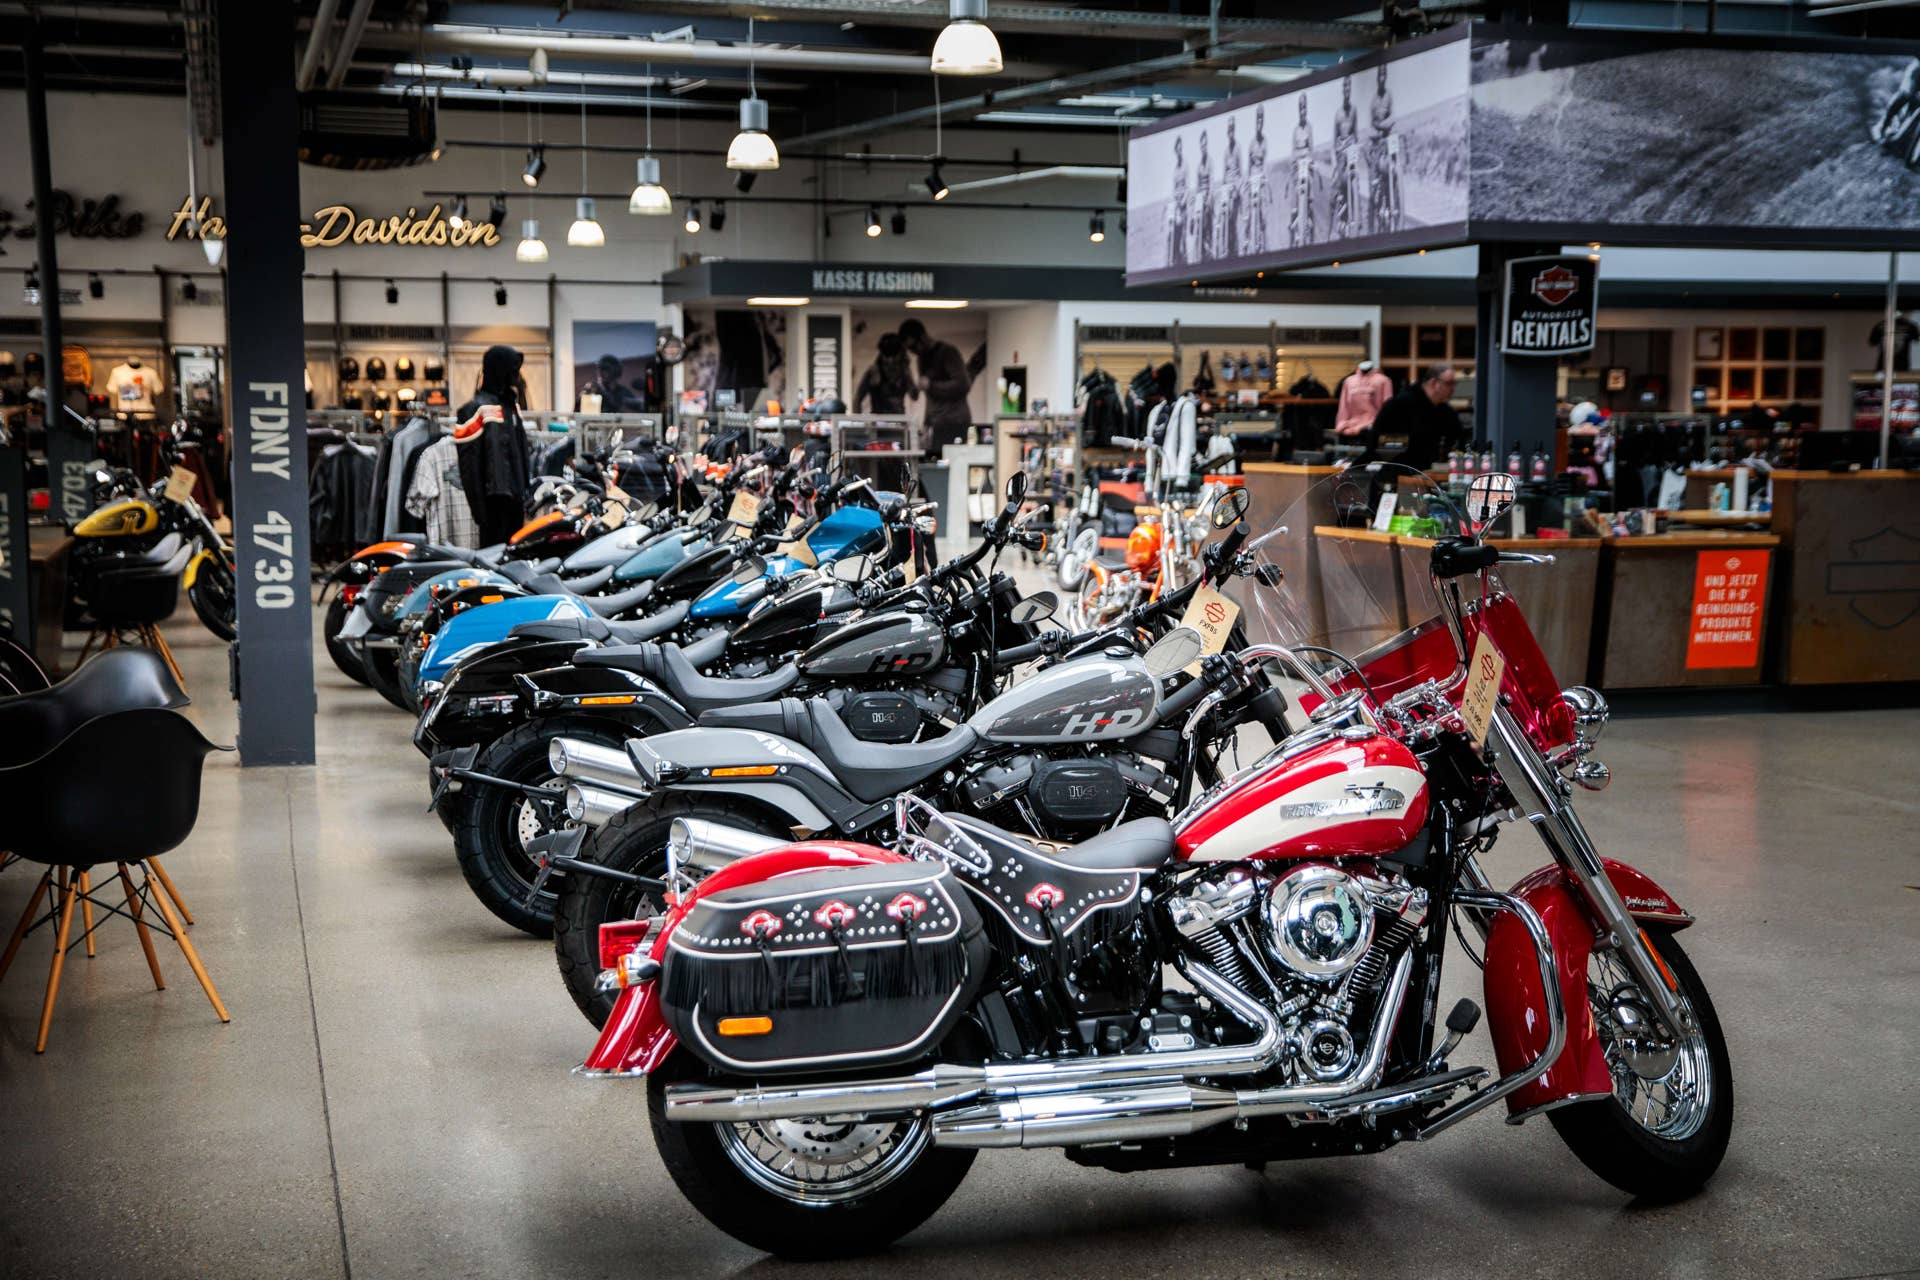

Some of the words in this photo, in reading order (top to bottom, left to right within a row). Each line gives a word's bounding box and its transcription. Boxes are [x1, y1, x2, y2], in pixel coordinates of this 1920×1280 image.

[812, 270, 865, 291] KASSE
[867, 271, 934, 293] FASHION
[1511, 317, 1590, 347] RENTALS
[249, 382, 291, 480] FDNY
[253, 510, 295, 609] 4730
[1704, 575, 1726, 587] UND
[1728, 574, 1758, 587] JETZT
[1709, 589, 1725, 601] DIE
[1696, 602, 1759, 615] REINIGUNGS-
[1700, 616, 1752, 629] PRODUKTE
[1693, 630, 1755, 643] MITNEHMEN.
[872, 712, 896, 723] 114
[1060, 707, 1143, 737] H-D
[1068, 785, 1097, 798] 114
